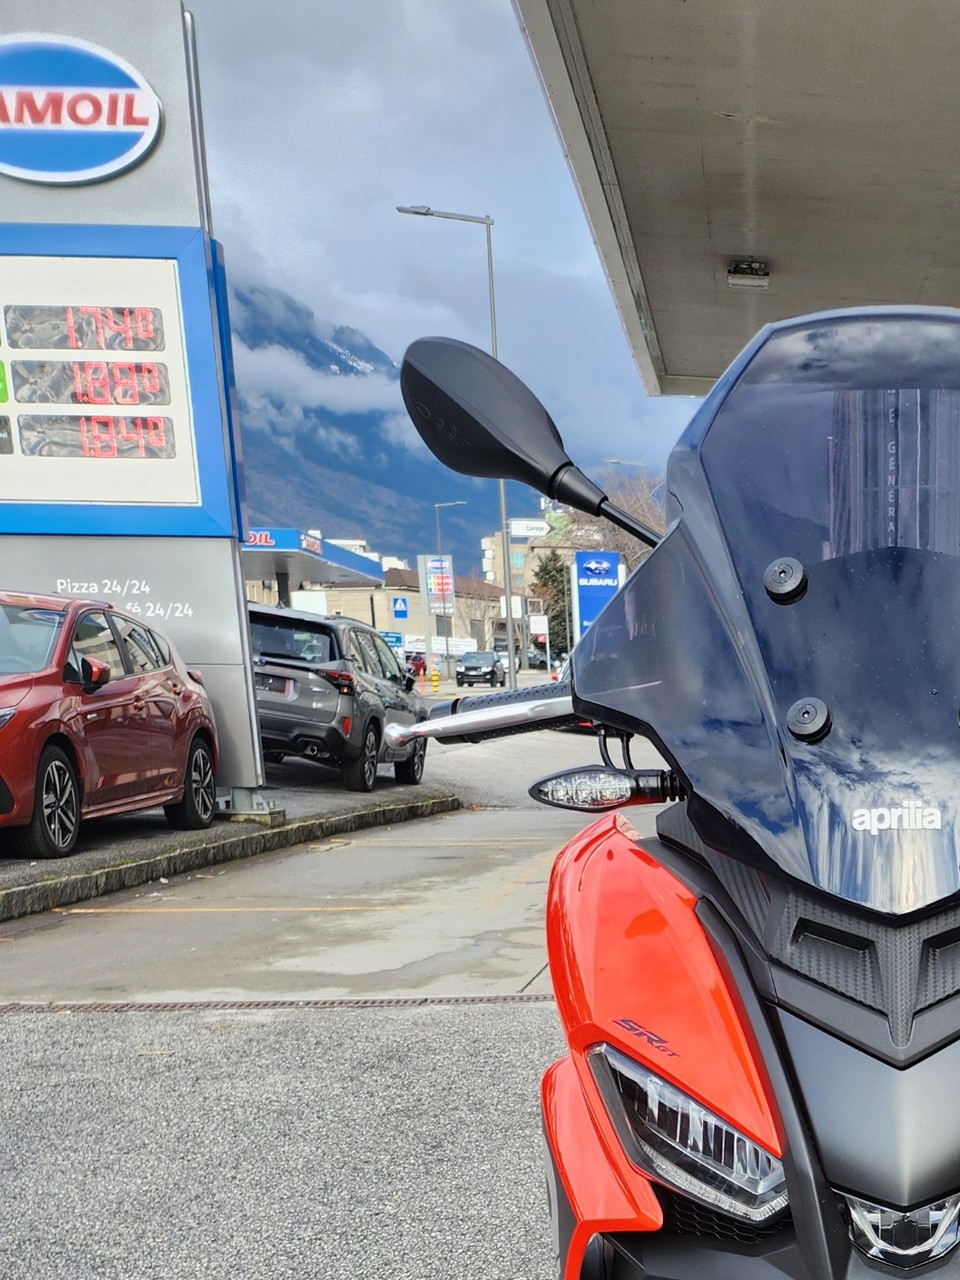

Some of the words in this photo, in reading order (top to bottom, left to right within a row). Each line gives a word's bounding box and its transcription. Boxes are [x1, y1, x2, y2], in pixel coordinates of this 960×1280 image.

[56, 578, 99, 594] Pizza
[101, 579, 150, 597] 24/24
[578, 577, 618, 587] SUBARU
[145, 602, 194, 620] 24/24
[851, 799, 941, 836] aprilia
[610, 1018, 669, 1046] SR
[654, 1045, 681, 1057] GT
